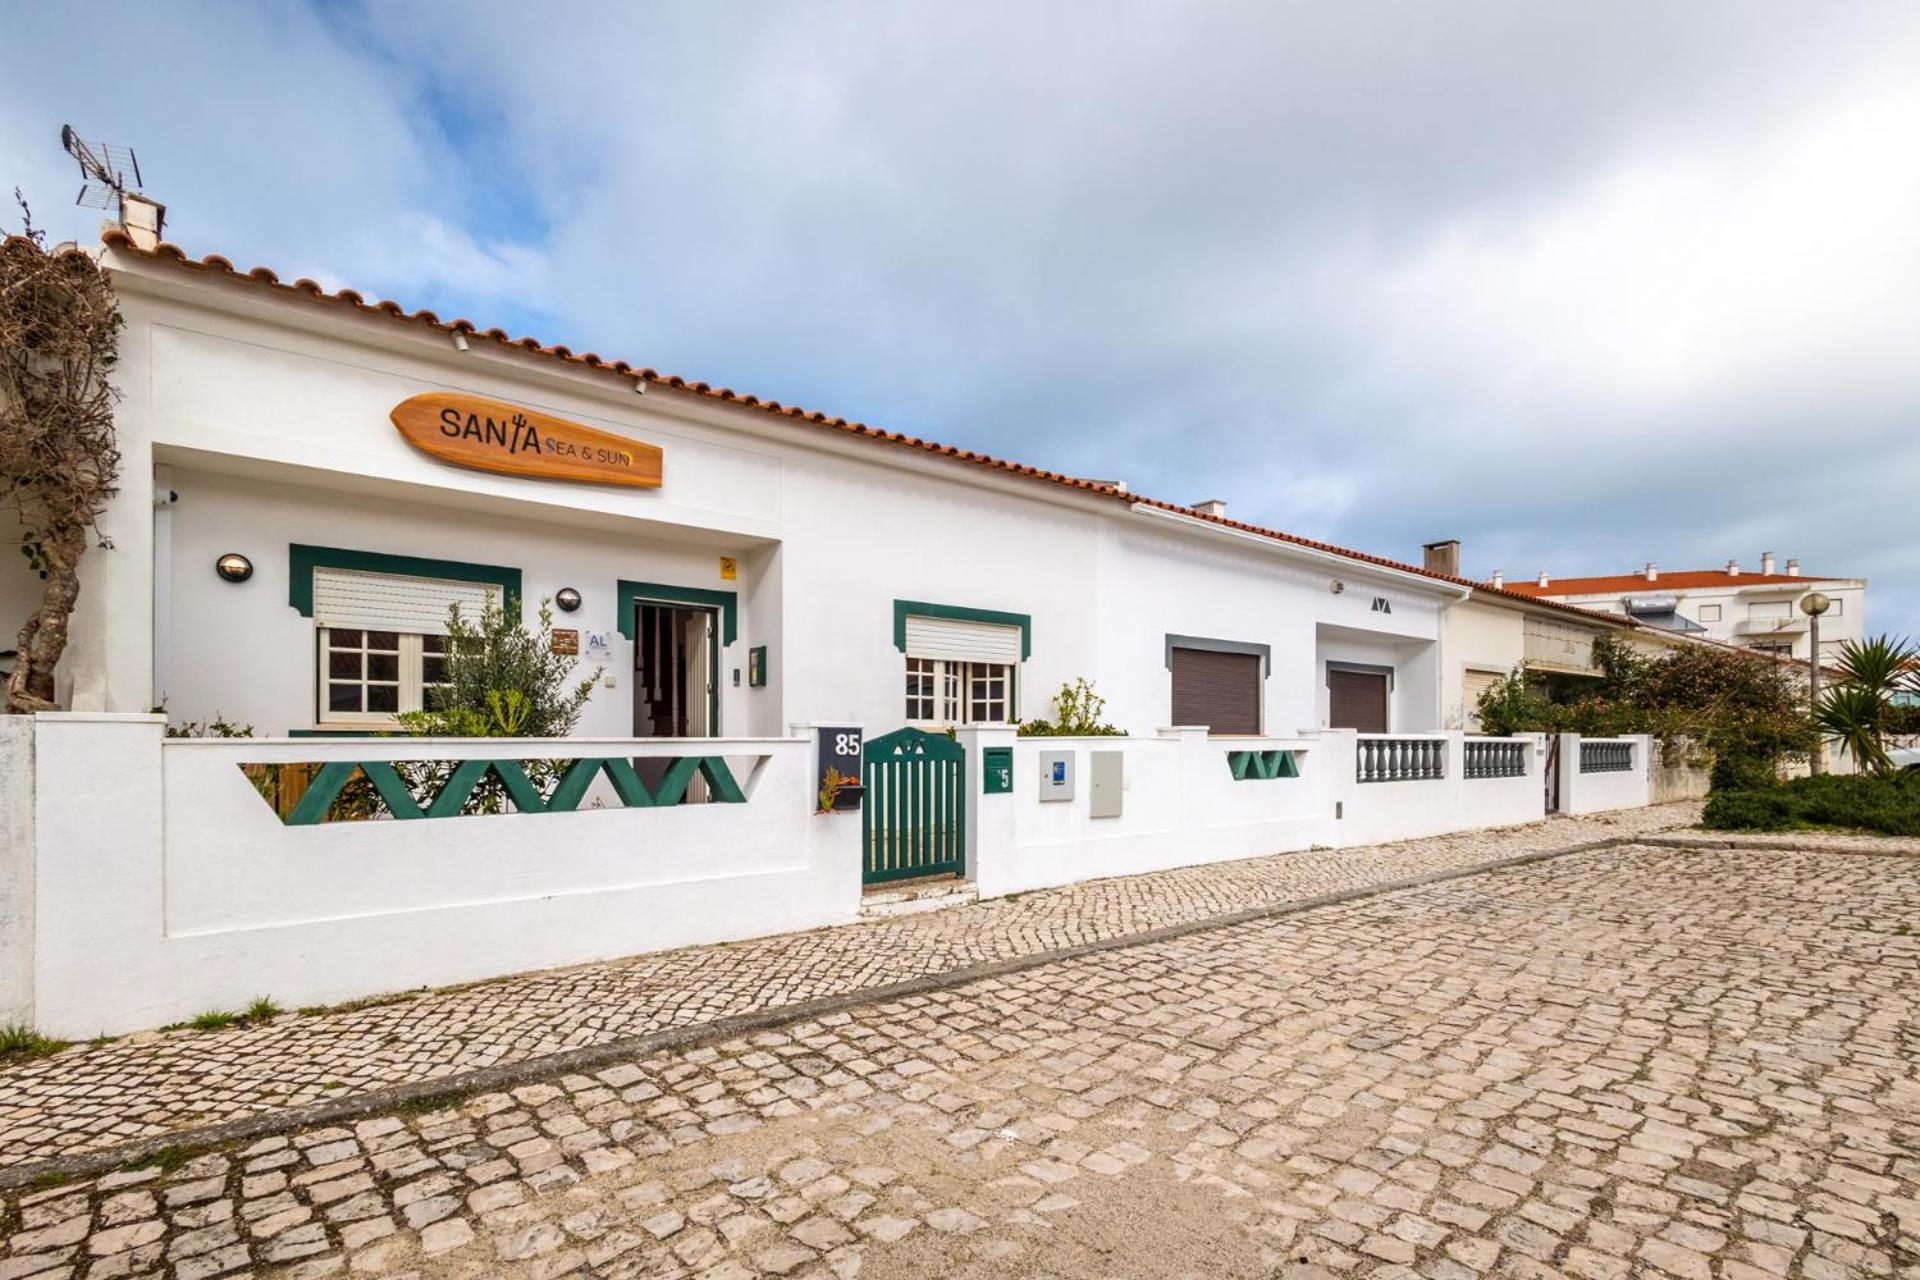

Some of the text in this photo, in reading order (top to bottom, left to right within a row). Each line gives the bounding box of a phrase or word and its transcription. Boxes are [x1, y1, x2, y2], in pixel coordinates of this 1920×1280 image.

[545, 437, 577, 457] SEA
[581, 445, 593, 460] &
[597, 449, 631, 467] SUN
[589, 634, 607, 647] AL
[835, 733, 860, 756] 85
